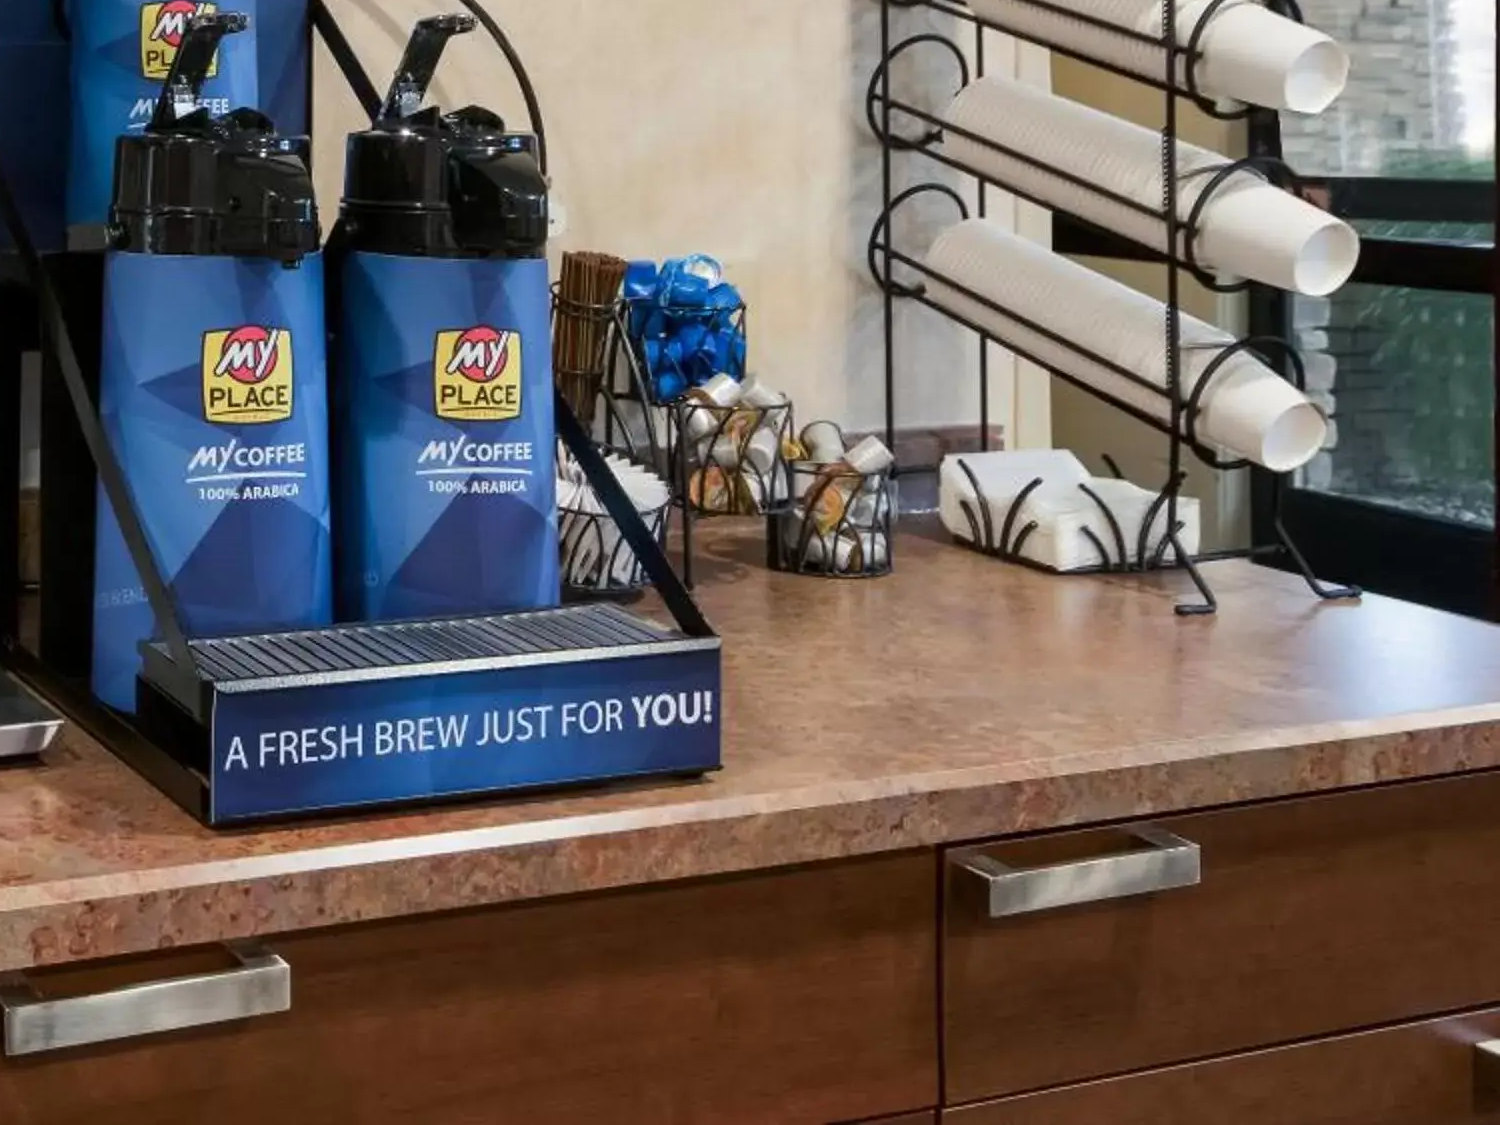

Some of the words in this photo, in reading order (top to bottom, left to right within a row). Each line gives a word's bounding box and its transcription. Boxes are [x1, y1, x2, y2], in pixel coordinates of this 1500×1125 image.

[209, 386, 289, 408] PLACE
[441, 385, 517, 406] PLACE
[199, 487, 241, 501] 100%
[243, 483, 299, 500] ARABICA
[428, 480, 468, 494] 100%
[471, 480, 527, 494] ARABICA
[224, 735, 249, 772] A
[260, 726, 364, 768] FRESH
[374, 714, 469, 755] BREW
[476, 705, 553, 747] JUST
[562, 699, 624, 738] FOR
[631, 690, 713, 730] YOU!
